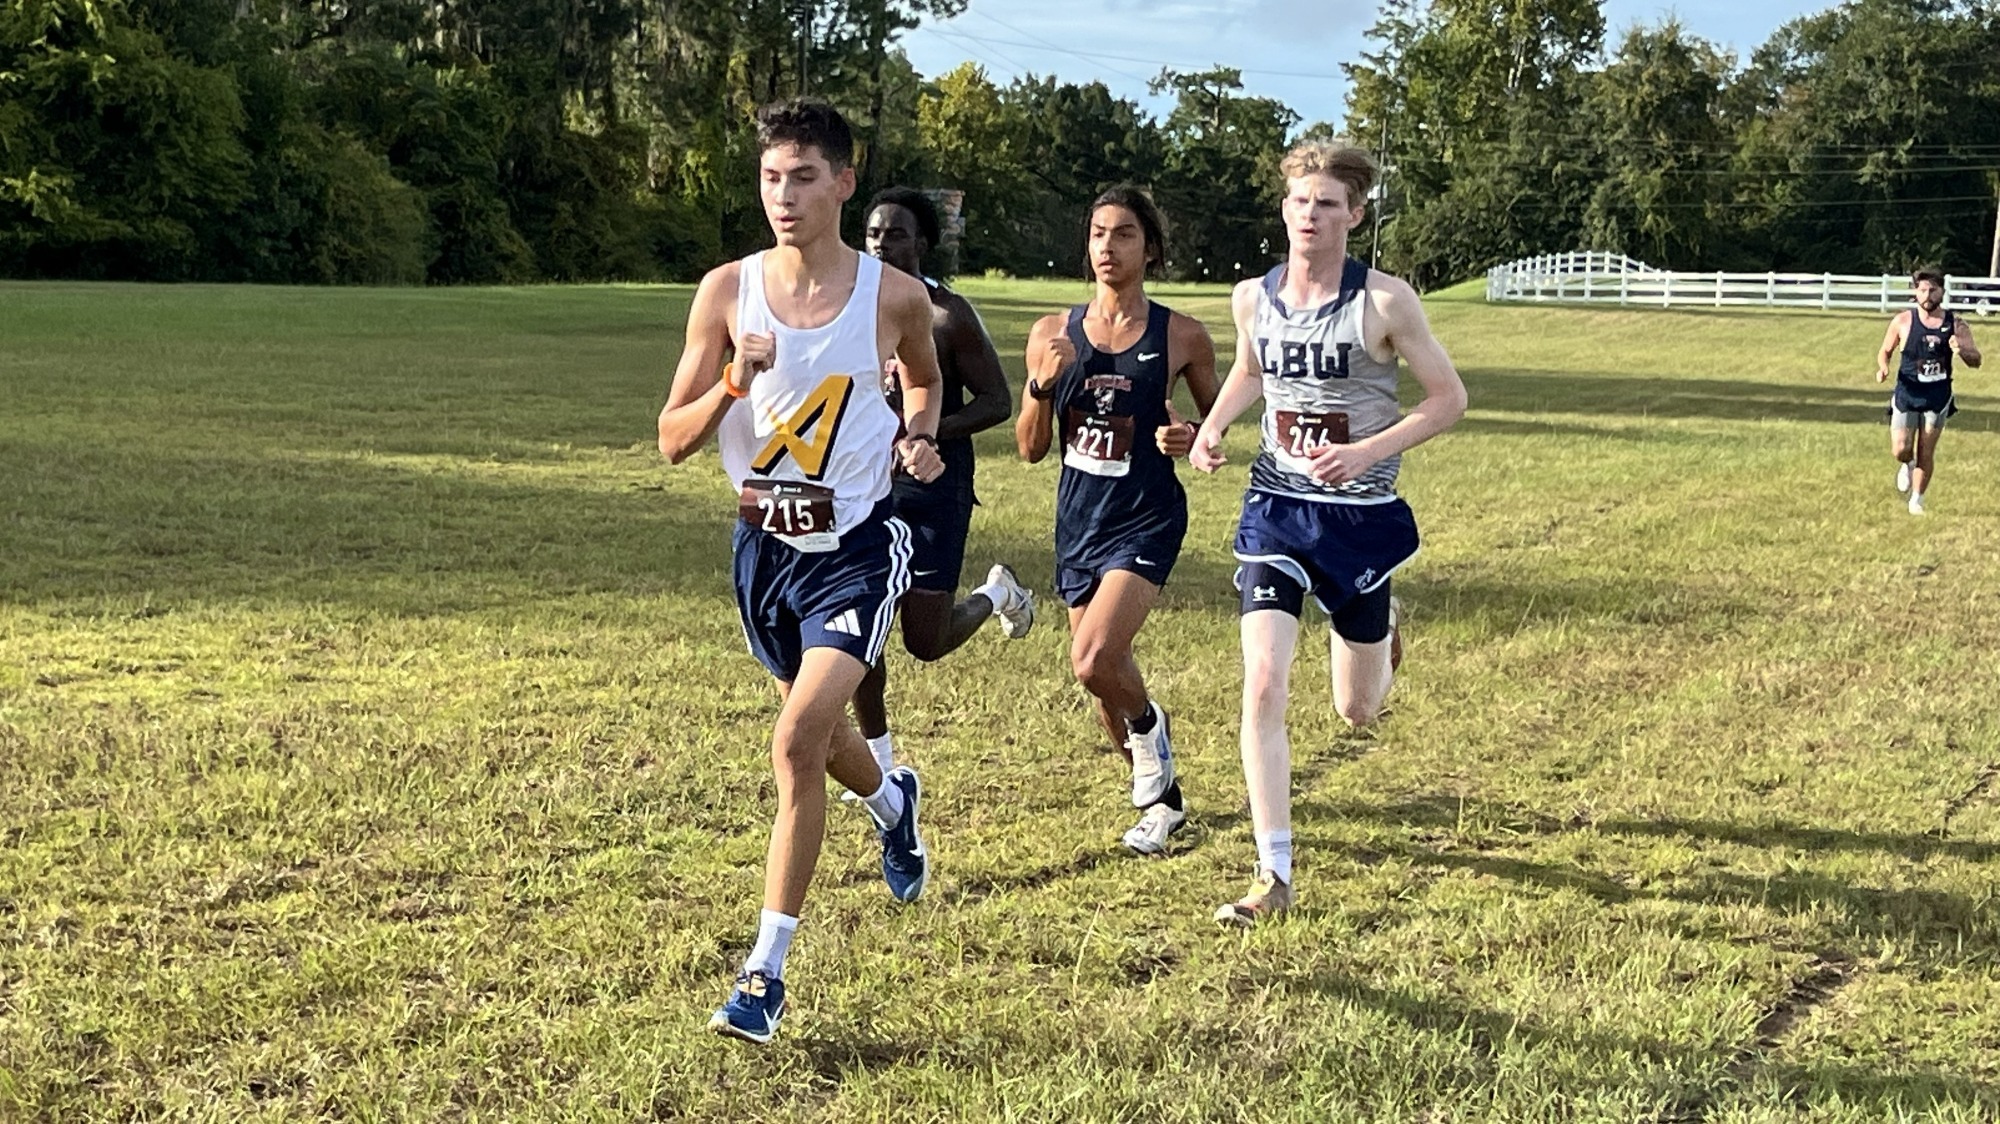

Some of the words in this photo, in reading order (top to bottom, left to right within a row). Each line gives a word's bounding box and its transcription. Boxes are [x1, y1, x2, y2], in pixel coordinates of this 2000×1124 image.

[1258, 338, 1352, 379] LBW
[751, 374, 854, 481] A
[1076, 425, 1114, 458] 221
[1289, 425, 1331, 458] 266
[758, 498, 814, 532] 215
